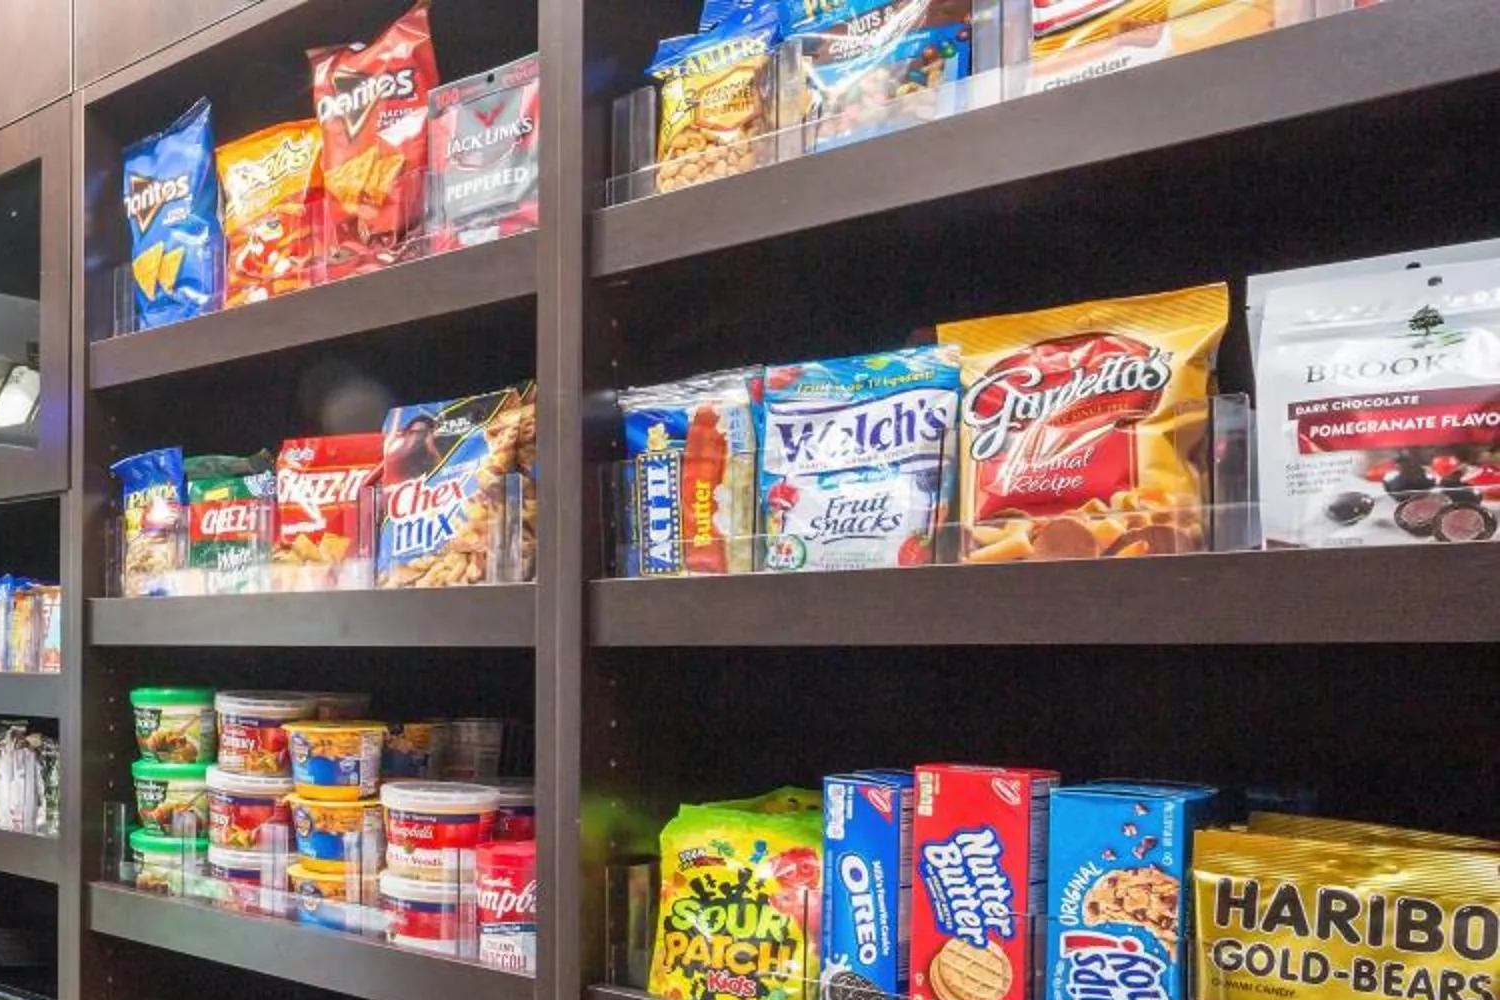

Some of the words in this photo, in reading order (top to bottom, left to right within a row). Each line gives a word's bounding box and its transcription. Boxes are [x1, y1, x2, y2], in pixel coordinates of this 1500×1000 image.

[317, 69, 415, 121] Doritos
[775, 398, 948, 465] Welch's
[963, 349, 1172, 461] Gardetto's
[1295, 403, 1329, 416] DARK
[1331, 394, 1420, 413] CHOCOLATE
[1309, 415, 1437, 439] POMEGRANATE
[390, 472, 472, 520] Chex
[691, 479, 711, 548] Butter
[825, 491, 892, 520] Fruit
[840, 853, 878, 966] OREO
[923, 840, 988, 949] Butter
[955, 826, 1014, 940] Nutter
[1059, 862, 1103, 926] ORIGINAL
[671, 898, 791, 943] SOUR
[1215, 877, 1500, 962] HARIBO
[663, 930, 797, 976] PATCH
